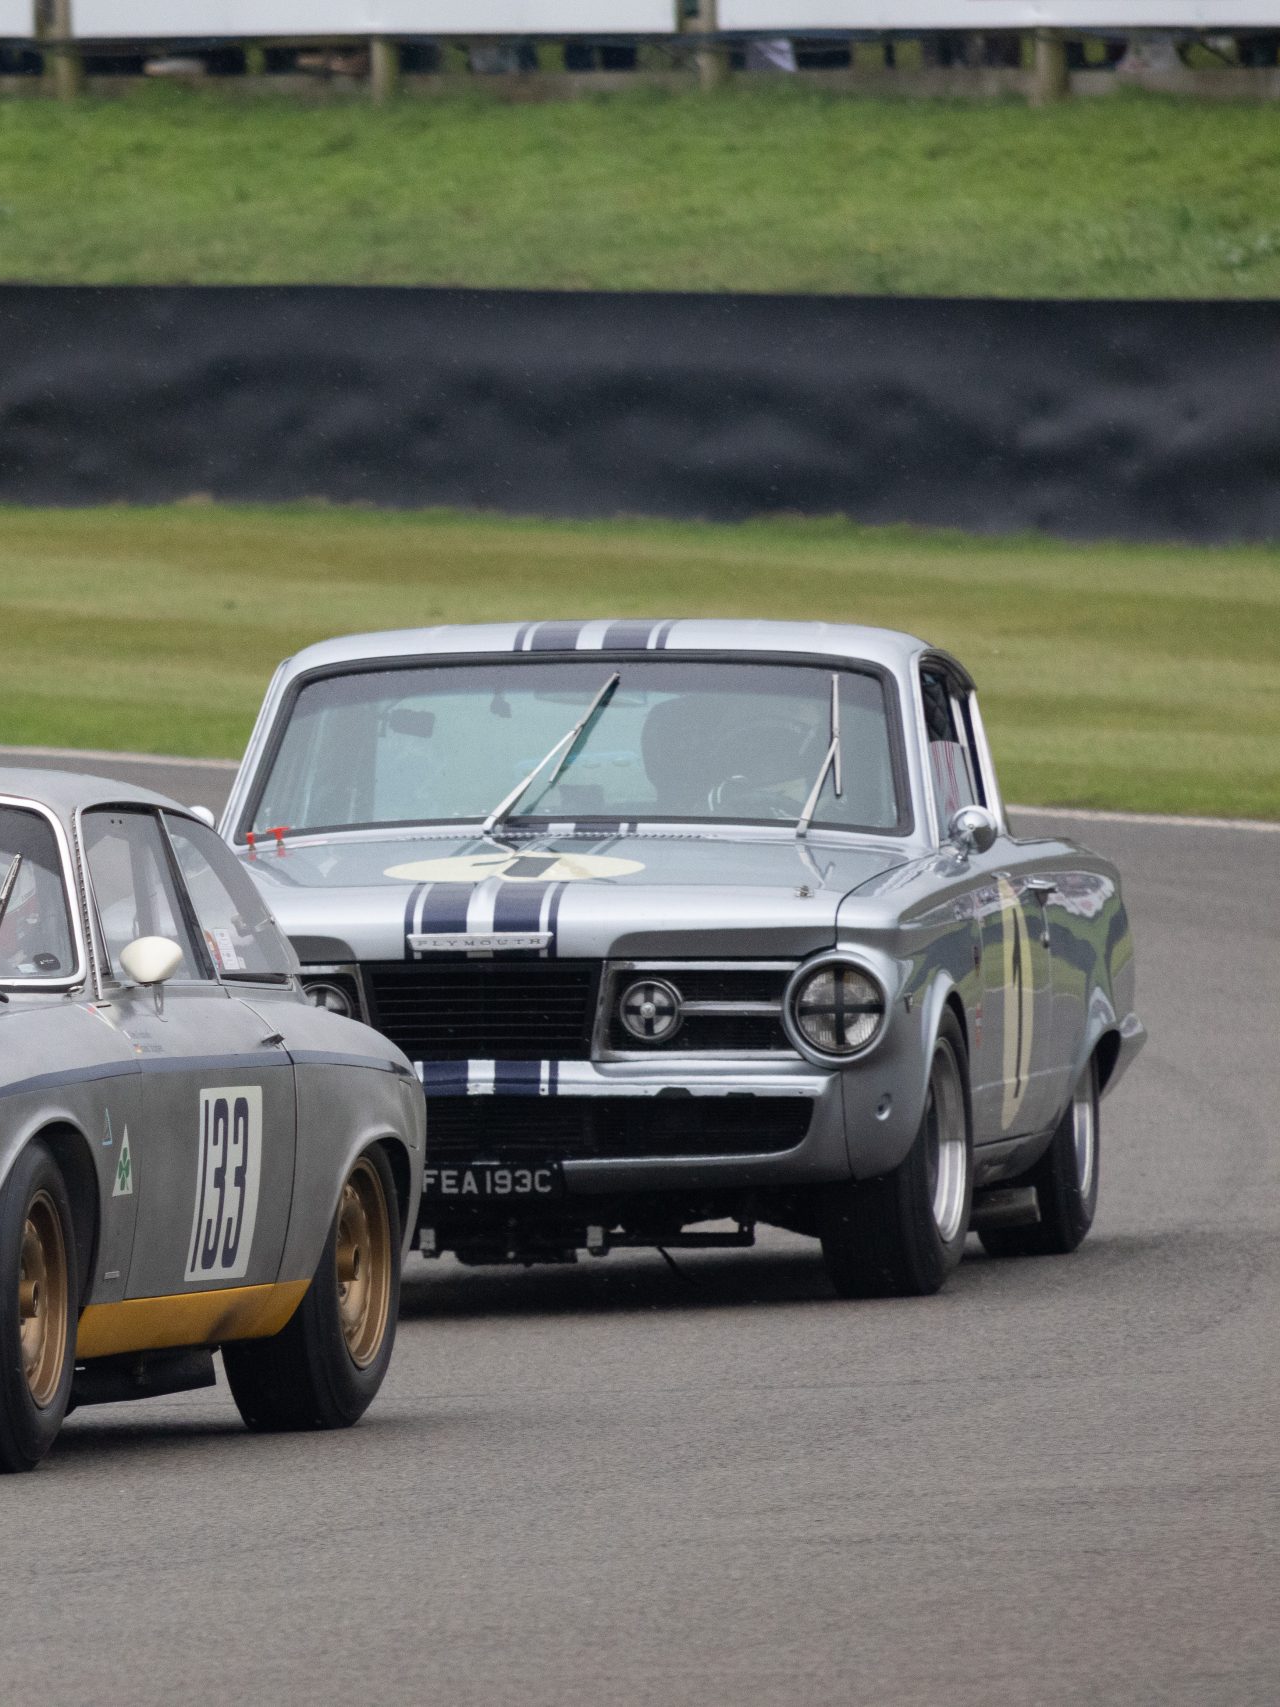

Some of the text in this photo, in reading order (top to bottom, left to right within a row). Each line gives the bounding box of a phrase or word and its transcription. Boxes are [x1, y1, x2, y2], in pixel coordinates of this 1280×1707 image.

[417, 938, 542, 947] PLYMOUTH
[190, 1097, 249, 1273] 133
[423, 1169, 552, 1194] FEA 193C
